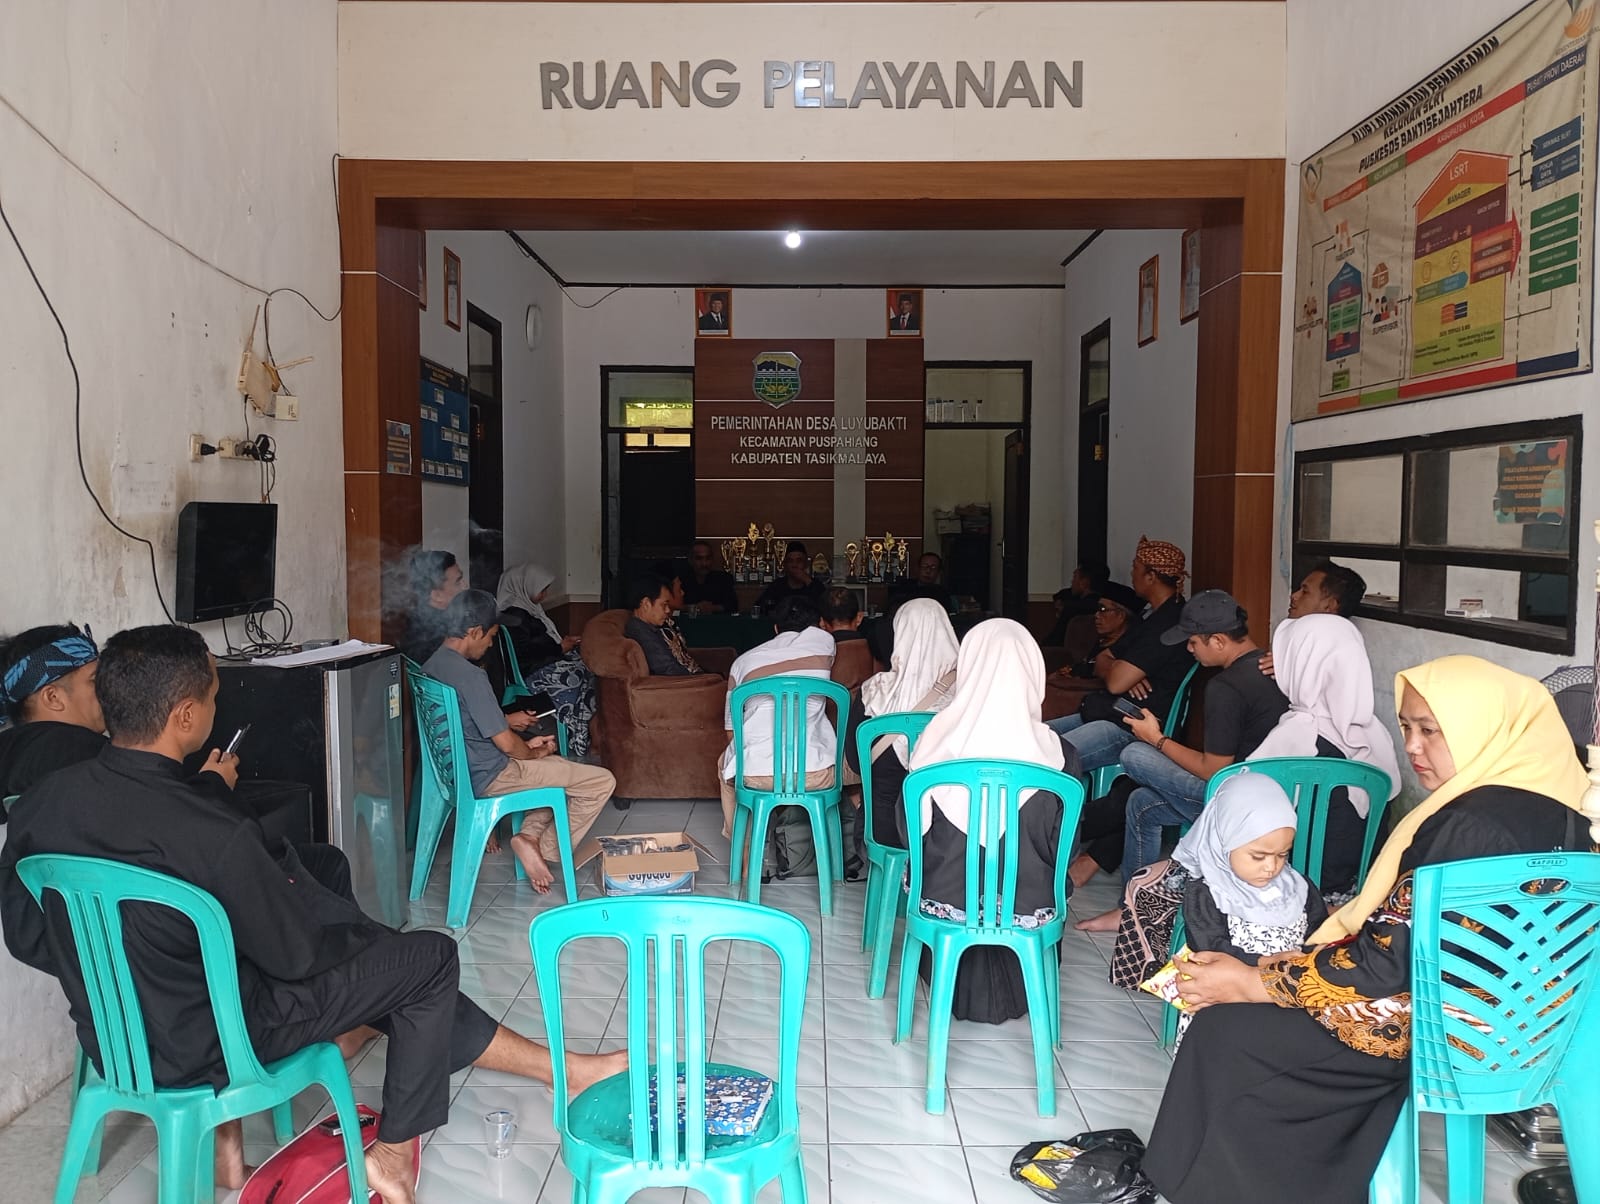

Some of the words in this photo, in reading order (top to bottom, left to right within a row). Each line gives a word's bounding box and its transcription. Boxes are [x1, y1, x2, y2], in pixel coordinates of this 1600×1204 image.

[1426, 36, 1499, 93] PENANGANAN
[539, 58, 740, 110] RUANG
[763, 60, 1083, 110] PELAYANAN
[711, 416, 803, 430] PEMERINTAHAN
[806, 416, 836, 430] DESA
[841, 416, 907, 430] LUYUBAKTI
[740, 436, 806, 448] KECAMATAN
[809, 436, 878, 448] PUSPAHIANG
[731, 453, 801, 464] KABUPATEN
[805, 453, 887, 464] TASIKMALAYA
